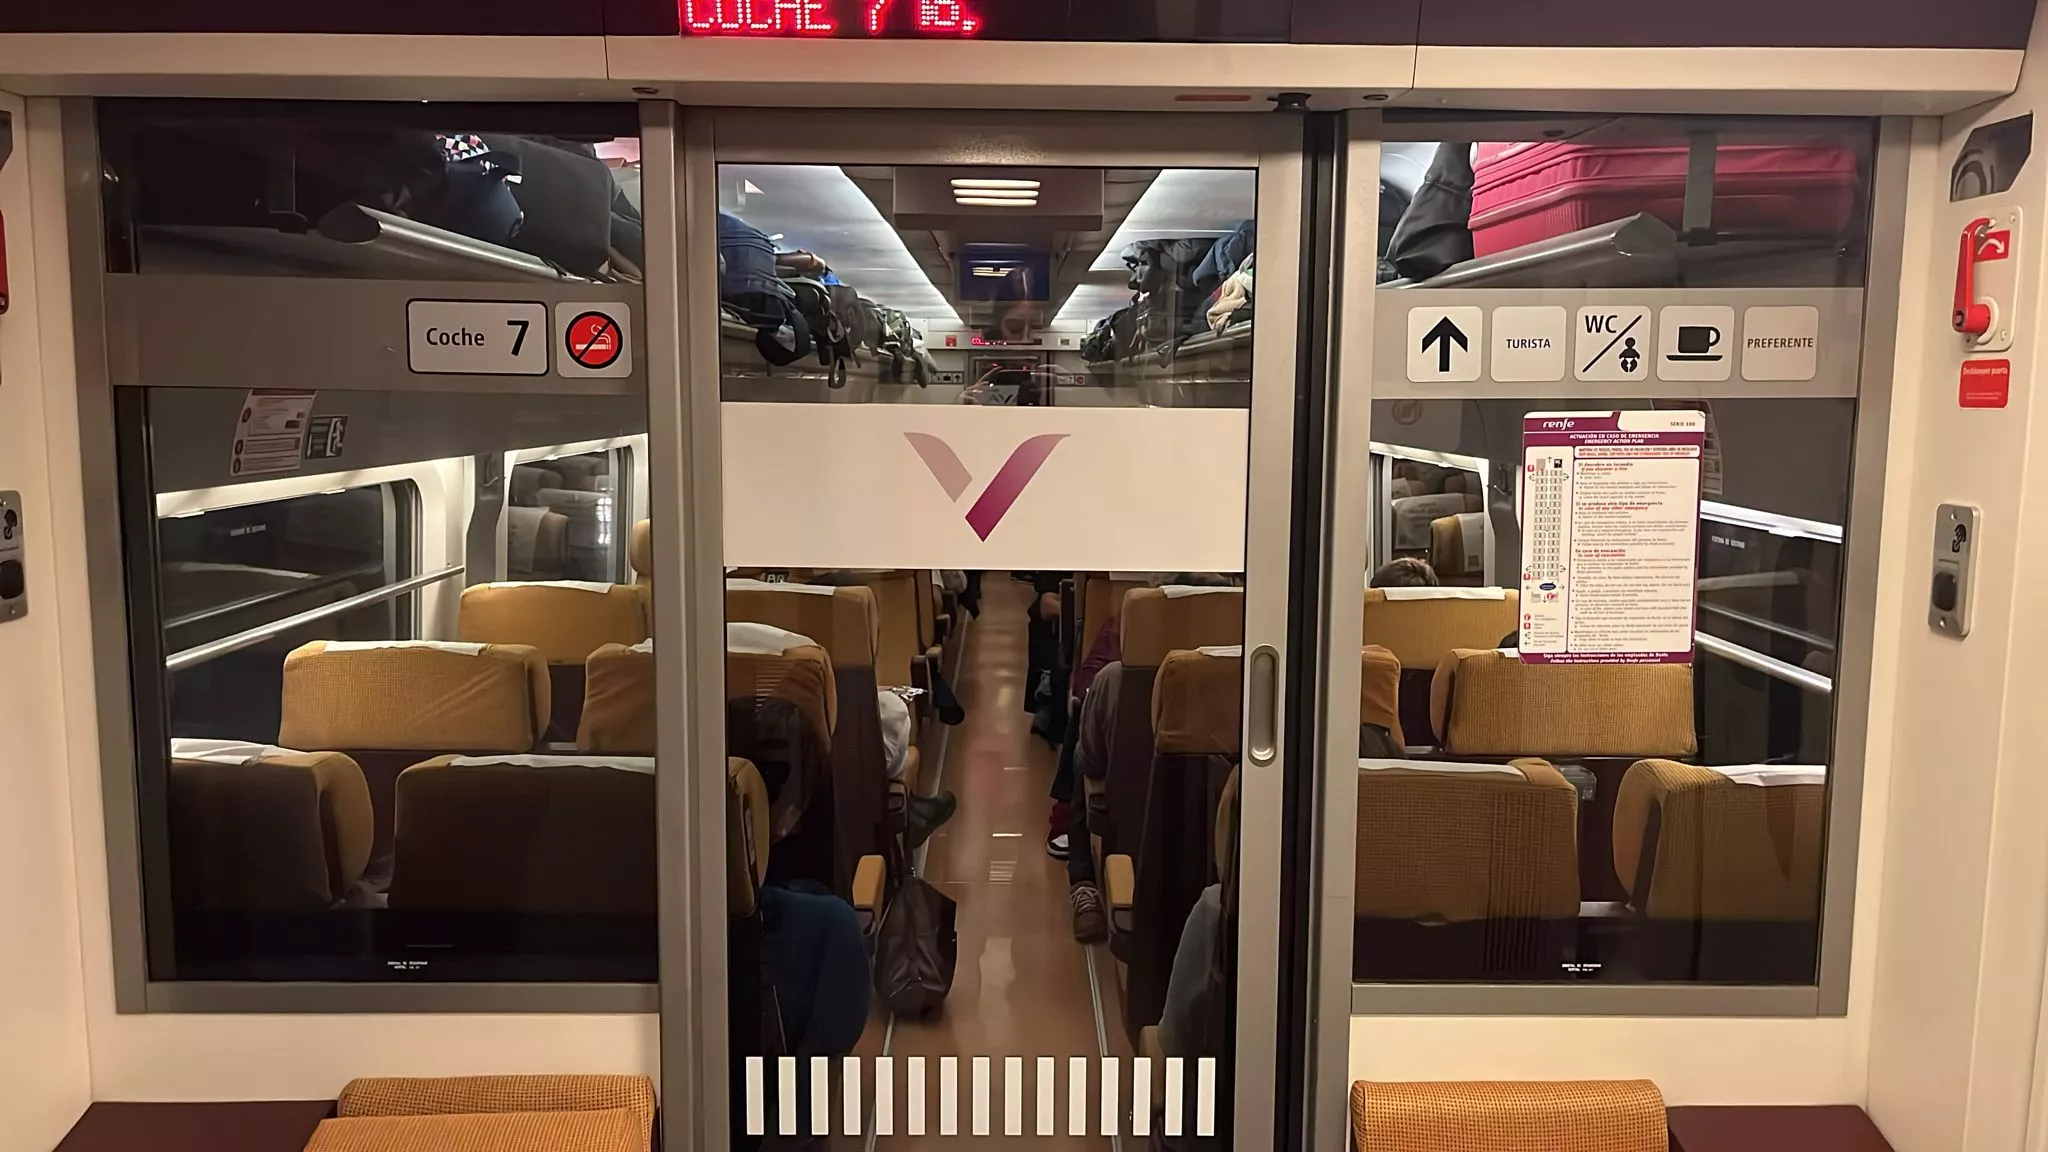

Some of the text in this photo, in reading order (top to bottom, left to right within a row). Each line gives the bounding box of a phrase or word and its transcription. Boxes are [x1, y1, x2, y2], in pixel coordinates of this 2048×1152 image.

[1585, 315, 1617, 334] WC
[426, 320, 530, 357] Coche 7
[1506, 338, 1551, 350] TURISTA
[1747, 337, 1814, 349] PREFERENTE
[1542, 418, 1575, 431] renfe
